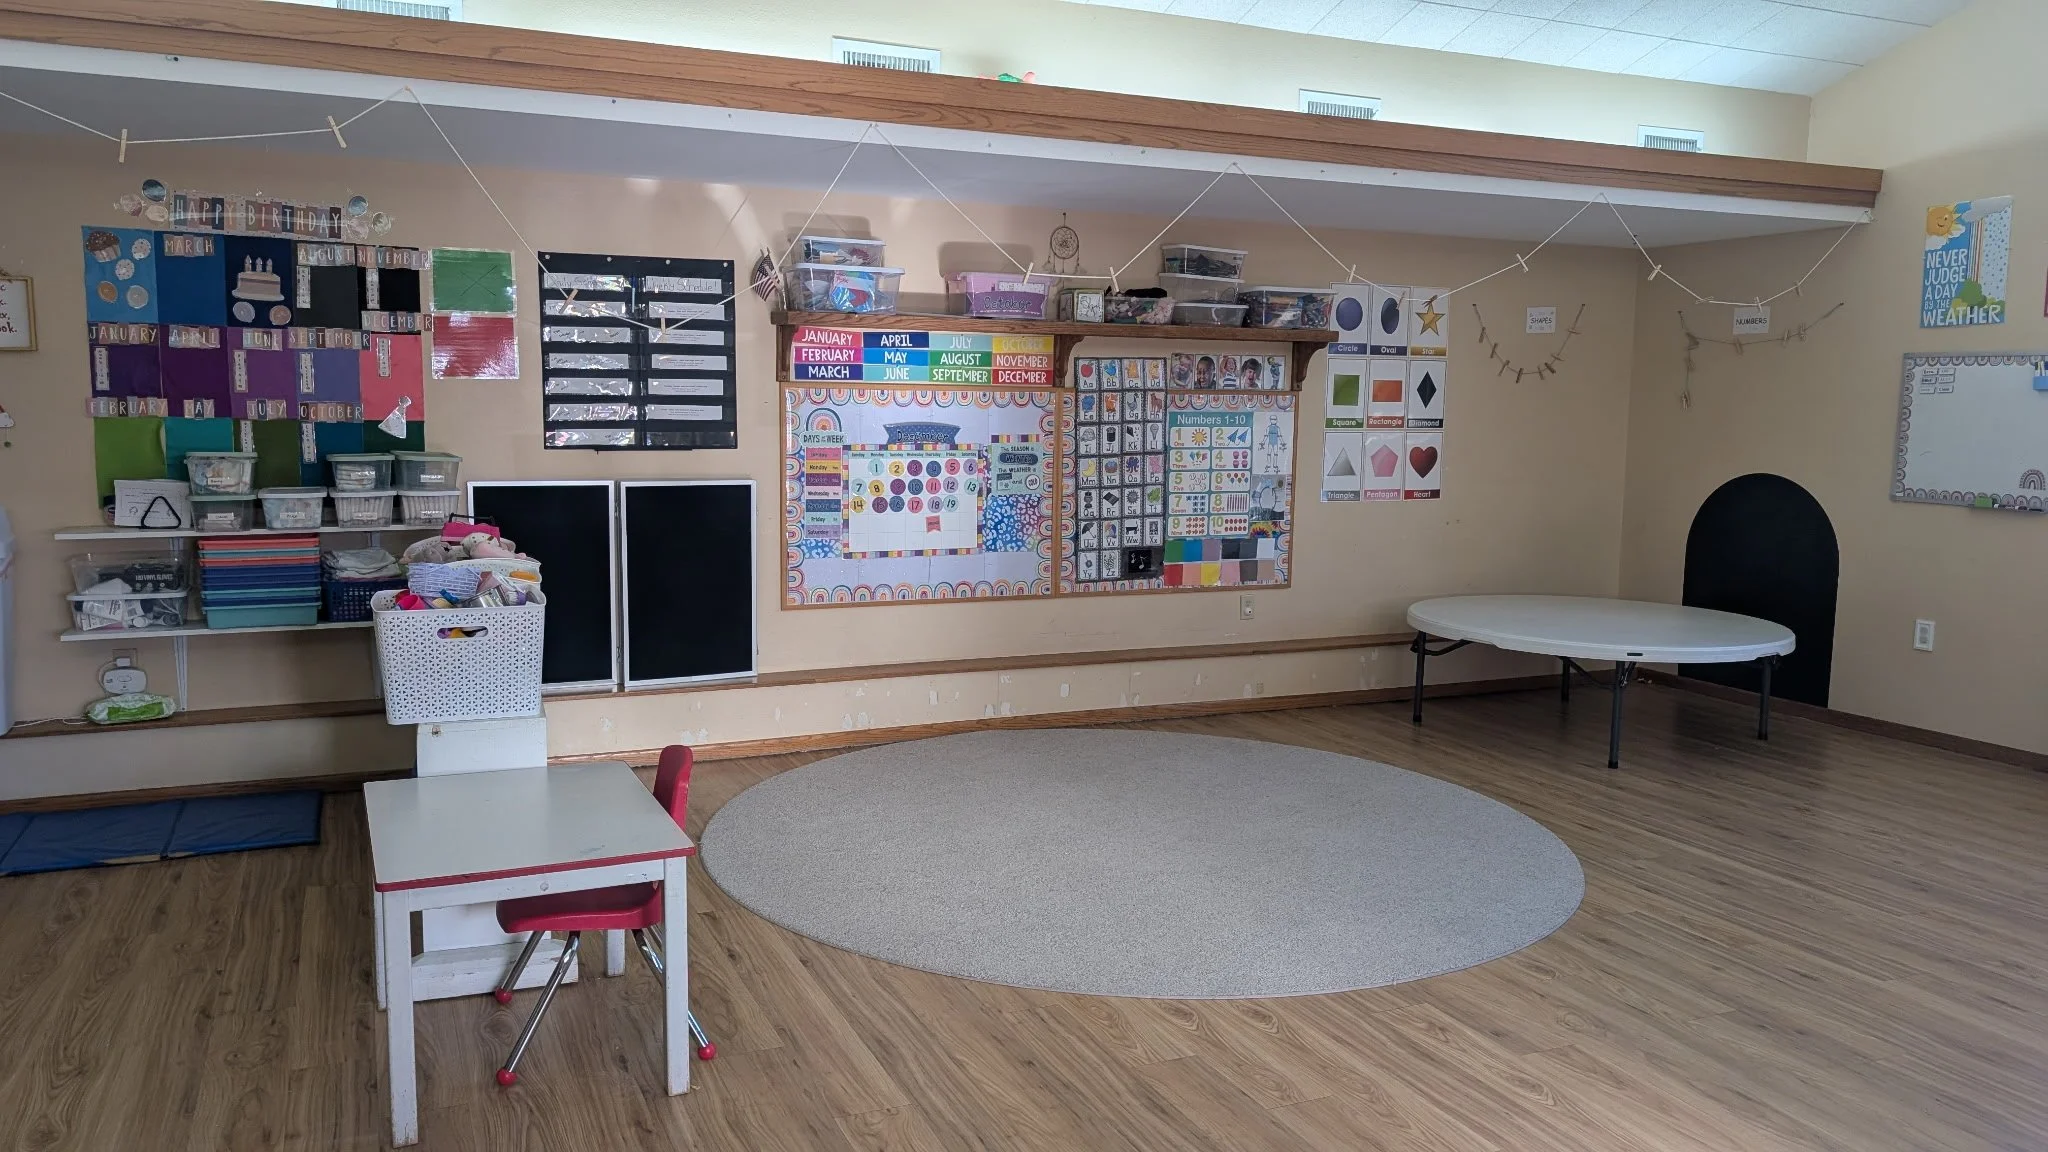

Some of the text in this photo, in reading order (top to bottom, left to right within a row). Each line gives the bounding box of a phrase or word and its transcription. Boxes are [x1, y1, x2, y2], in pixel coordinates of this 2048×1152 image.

[175, 199, 340, 239] HAPPY BIRTHDAY
[164, 239, 214, 253] MARCH
[299, 247, 352, 266] AUGUST
[358, 250, 429, 268] NOVEMBER
[1926, 248, 1968, 269] NEVER
[1924, 266, 1967, 286] JUDGE
[1924, 283, 1958, 301] A DAY
[1924, 299, 1950, 310] BY THE
[364, 312, 432, 329] DECEMBER
[1530, 316, 1553, 325] SHAPES
[1923, 304, 2001, 327] WEATHER
[1735, 317, 1768, 326] NUMBERS
[88, 326, 157, 343] JANUARY
[171, 329, 217, 345] APRIL
[244, 330, 280, 347] JUNE
[288, 331, 371, 347] SEPTEMBER
[801, 329, 853, 346] JANUARY
[880, 334, 913, 347] APRIL
[949, 335, 973, 349] JULY
[1337, 344, 1359, 352] Circle
[1380, 346, 1397, 354] Oval
[1421, 347, 1435, 355] Star
[801, 348, 855, 362] FEBRUARY
[884, 351, 908, 364] MAY
[940, 353, 982, 366] AUGUST
[996, 355, 1048, 368] NOVEMBER
[808, 365, 850, 379] MARCH
[883, 367, 910, 380] JUNE
[932, 368, 988, 383] SEPTEMBER
[998, 371, 1047, 383] DECEMBER
[1106, 378, 1116, 387] Bb
[1150, 379, 1160, 387] Dd
[89, 400, 168, 415] FEBRUARY
[184, 401, 214, 415] MAY
[248, 400, 285, 416] JULY
[300, 405, 362, 419] OCTOBER
[1177, 414, 1246, 425] Numbers 1-10
[1332, 419, 1357, 427] Square
[1368, 418, 1402, 427] Rectangle
[803, 434, 820, 444] DAYS
[826, 434, 845, 444] WEEK
[1175, 428, 1182, 441] 1
[1216, 428, 1224, 440] 2
[1106, 443, 1114, 453] Jj
[1128, 442, 1138, 450] Kk
[1150, 441, 1158, 450] Ll
[1175, 451, 1183, 463] 3
[1215, 450, 1224, 462] 4
[874, 463, 879, 473] 1
[894, 464, 901, 474] 2
[949, 462, 956, 472] 5
[967, 463, 974, 472] 6
[1081, 478, 1096, 486] Mm
[1106, 476, 1117, 484] Nn
[1150, 473, 1160, 483] Pp
[1174, 473, 1182, 485] 5
[1215, 473, 1223, 485] 6
[855, 483, 862, 493] 7
[873, 484, 880, 493] 8
[930, 481, 938, 492] 11
[945, 480, 956, 491] 12
[966, 481, 977, 492] 13
[1327, 491, 1355, 500] Triangle
[1366, 490, 1398, 499] Pentagon
[1413, 490, 1431, 498] Heart
[853, 500, 864, 511] 14
[910, 500, 921, 511] 17
[930, 499, 941, 511] 18
[946, 498, 957, 509] 19
[1174, 495, 1183, 507] 7
[1214, 495, 1223, 506] 8
[1106, 508, 1115, 516] Rr
[1149, 504, 1158, 513] Tt
[810, 516, 826, 524] Friday
[1172, 518, 1180, 529] 9
[1211, 516, 1224, 528] 10
[1126, 536, 1139, 544] Ww
[1149, 536, 1158, 544] Xx
[1083, 569, 1092, 578] Yy
[1106, 568, 1116, 577] Zz
